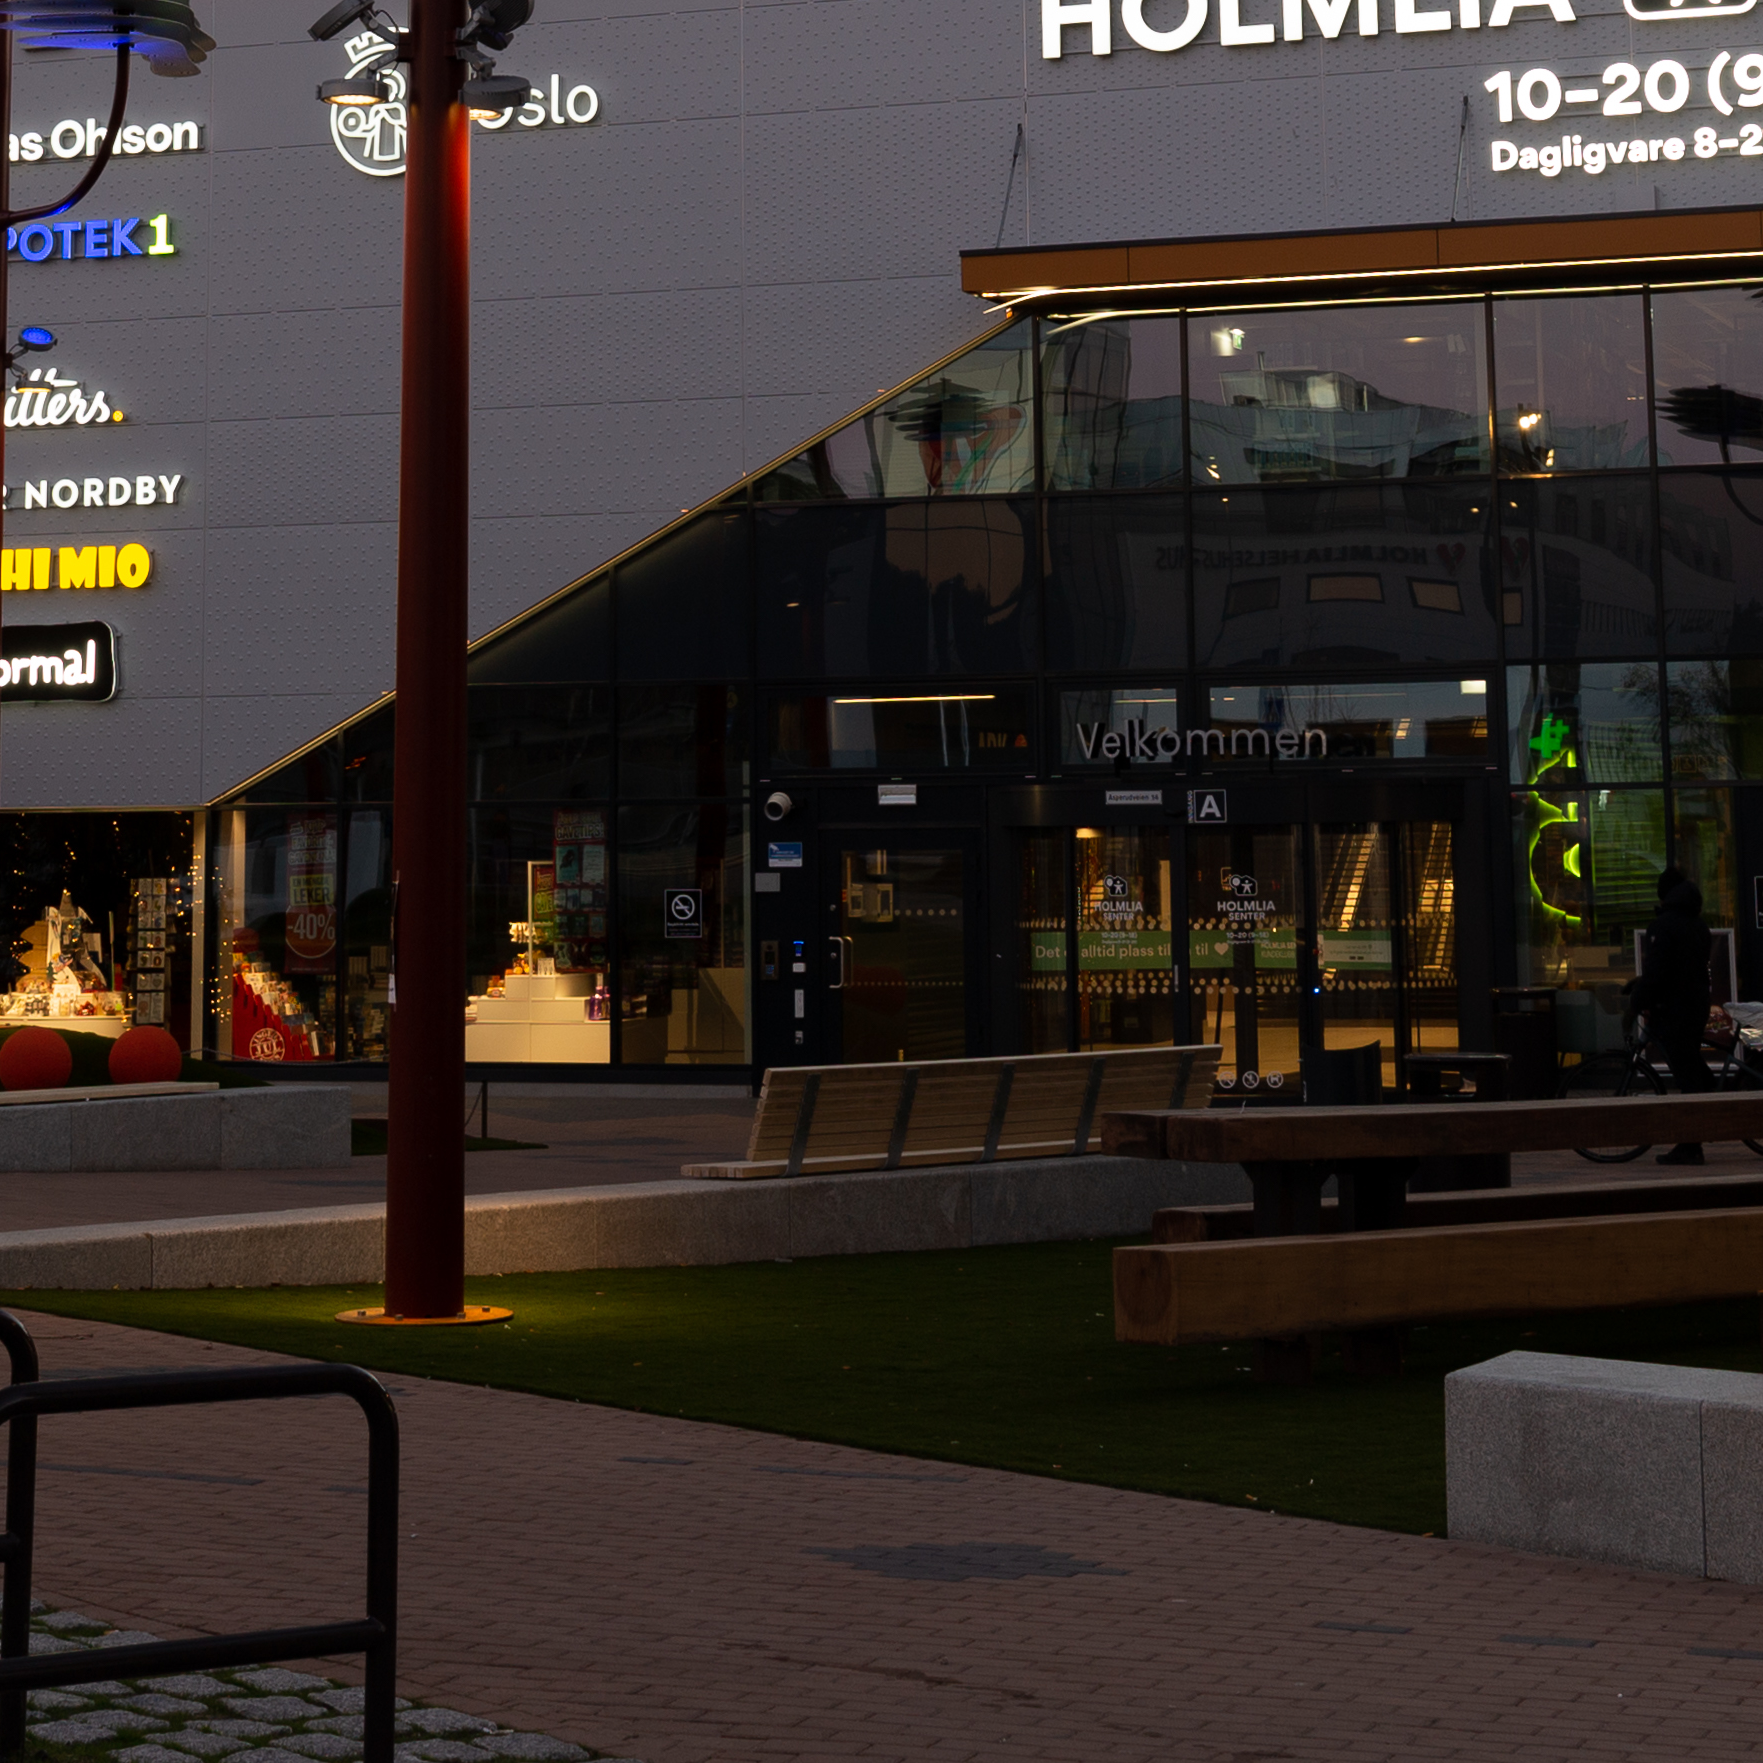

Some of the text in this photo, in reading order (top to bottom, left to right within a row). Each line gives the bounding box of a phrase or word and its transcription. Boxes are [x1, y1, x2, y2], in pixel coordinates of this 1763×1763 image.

[1491, 135, 1685, 178] Dagligvare
[25, 475, 183, 510] NORDBY
[59, 542, 152, 589] MIO
[1076, 720, 1327, 760] Velkommen
[1199, 794, 1222, 818] A
[293, 887, 330, 904] LEKER
[1094, 901, 1143, 912] HOLMLIA
[1217, 900, 1276, 912] HOLMLIA
[287, 913, 335, 940] -40%
[1103, 912, 1134, 921] SENTER
[1228, 912, 1266, 921] SENTER
[1035, 945, 1060, 958] Det
[1081, 944, 1115, 958] alltid
[1119, 945, 1154, 959] plass
[1195, 942, 1208, 956] til
